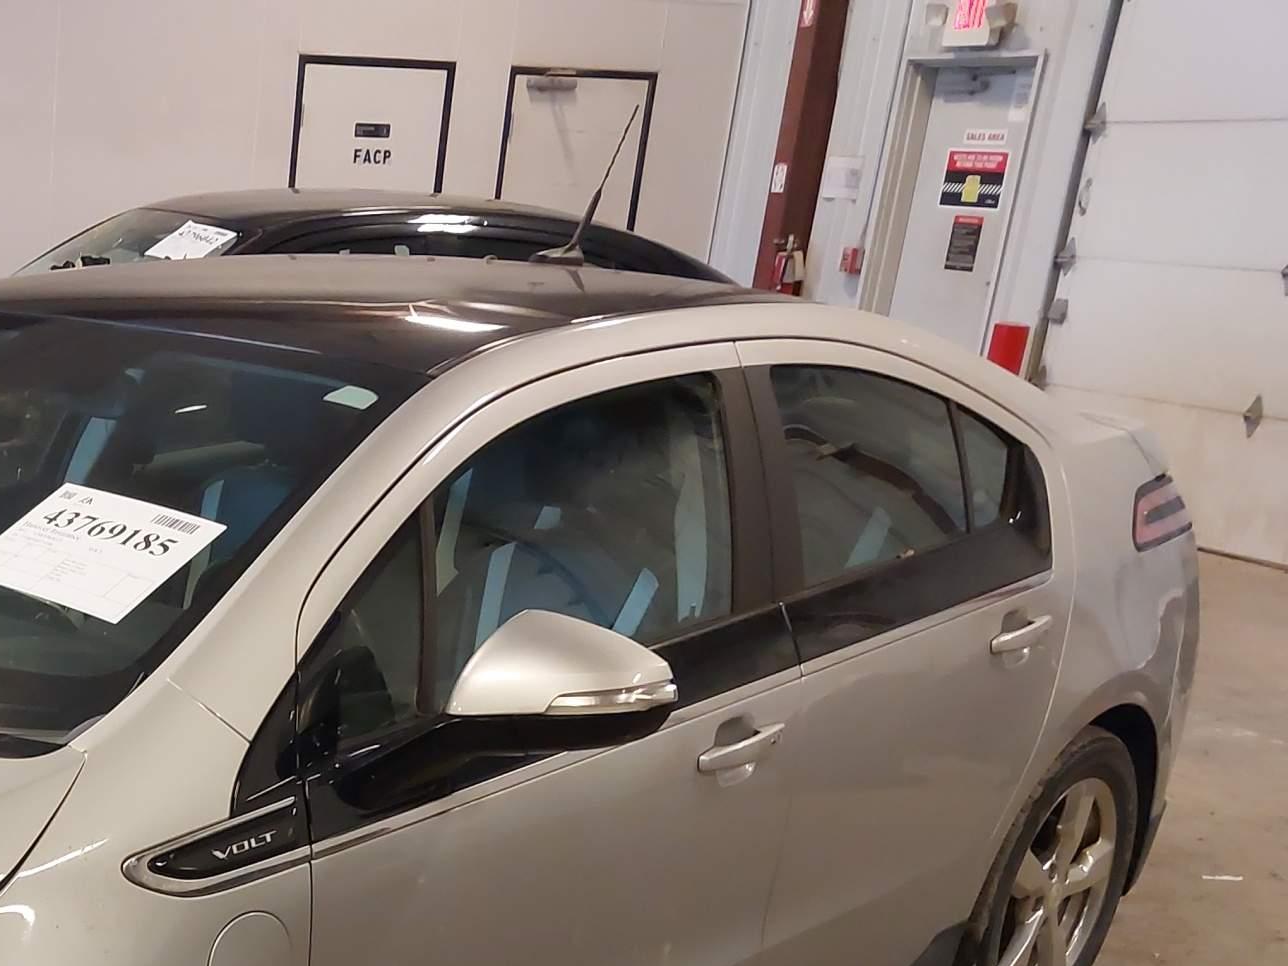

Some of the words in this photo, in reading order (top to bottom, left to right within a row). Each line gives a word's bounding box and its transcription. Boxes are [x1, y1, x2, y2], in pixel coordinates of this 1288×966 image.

[353, 149, 391, 164] FACP
[43, 508, 178, 557] 43769185
[212, 830, 277, 860] VOLT
